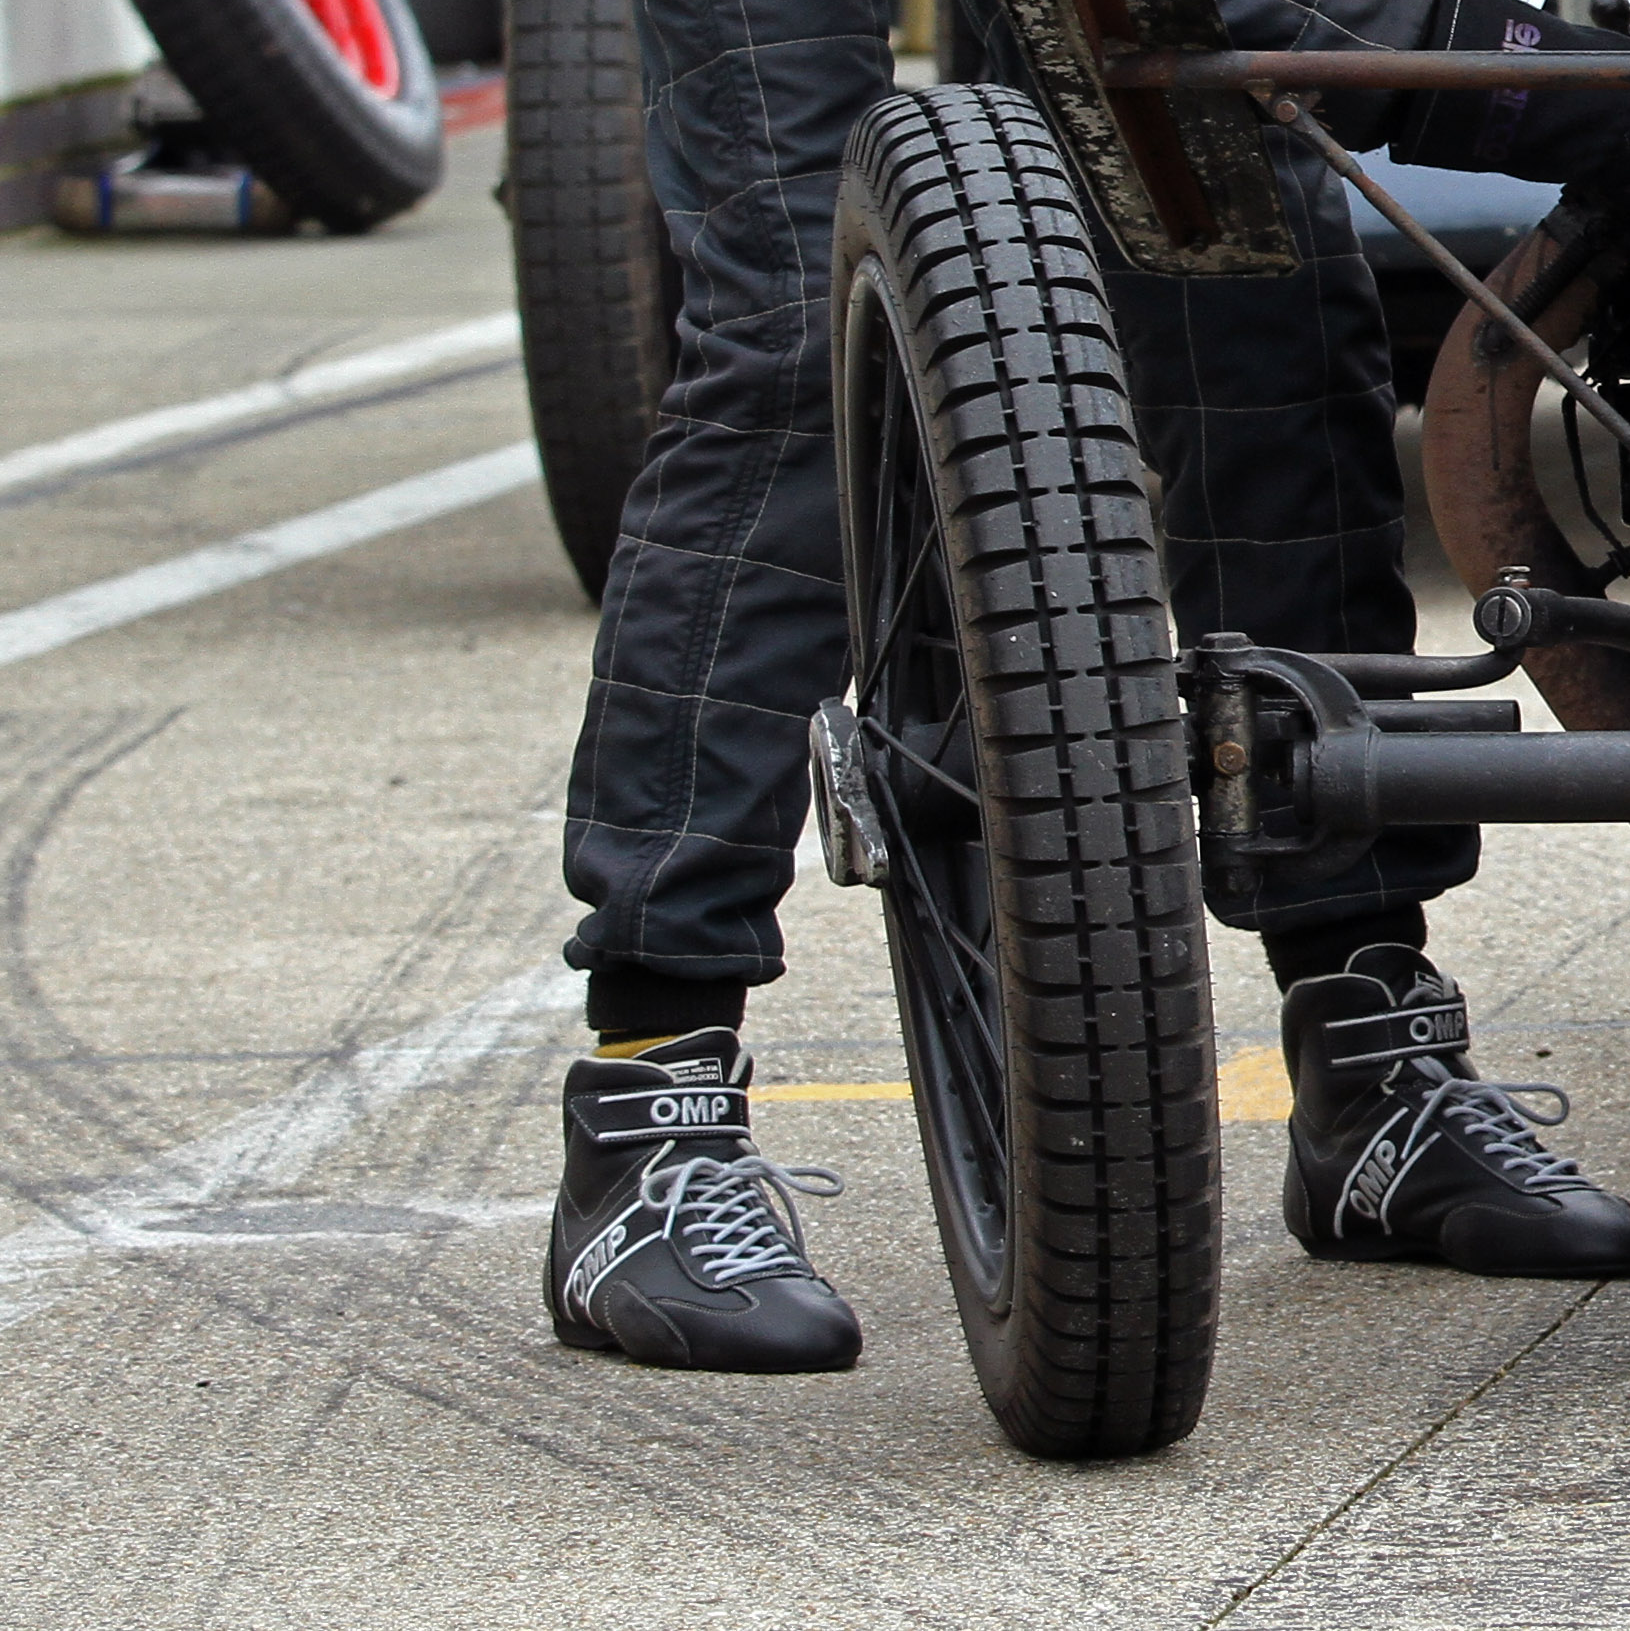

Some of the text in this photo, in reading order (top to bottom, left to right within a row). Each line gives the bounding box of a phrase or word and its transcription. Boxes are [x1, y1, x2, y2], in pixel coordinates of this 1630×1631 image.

[1409, 1010, 1465, 1044] OMP
[650, 1095, 730, 1125] OMP
[1345, 1139, 1398, 1222] OMP
[570, 1224, 628, 1309] OMP
